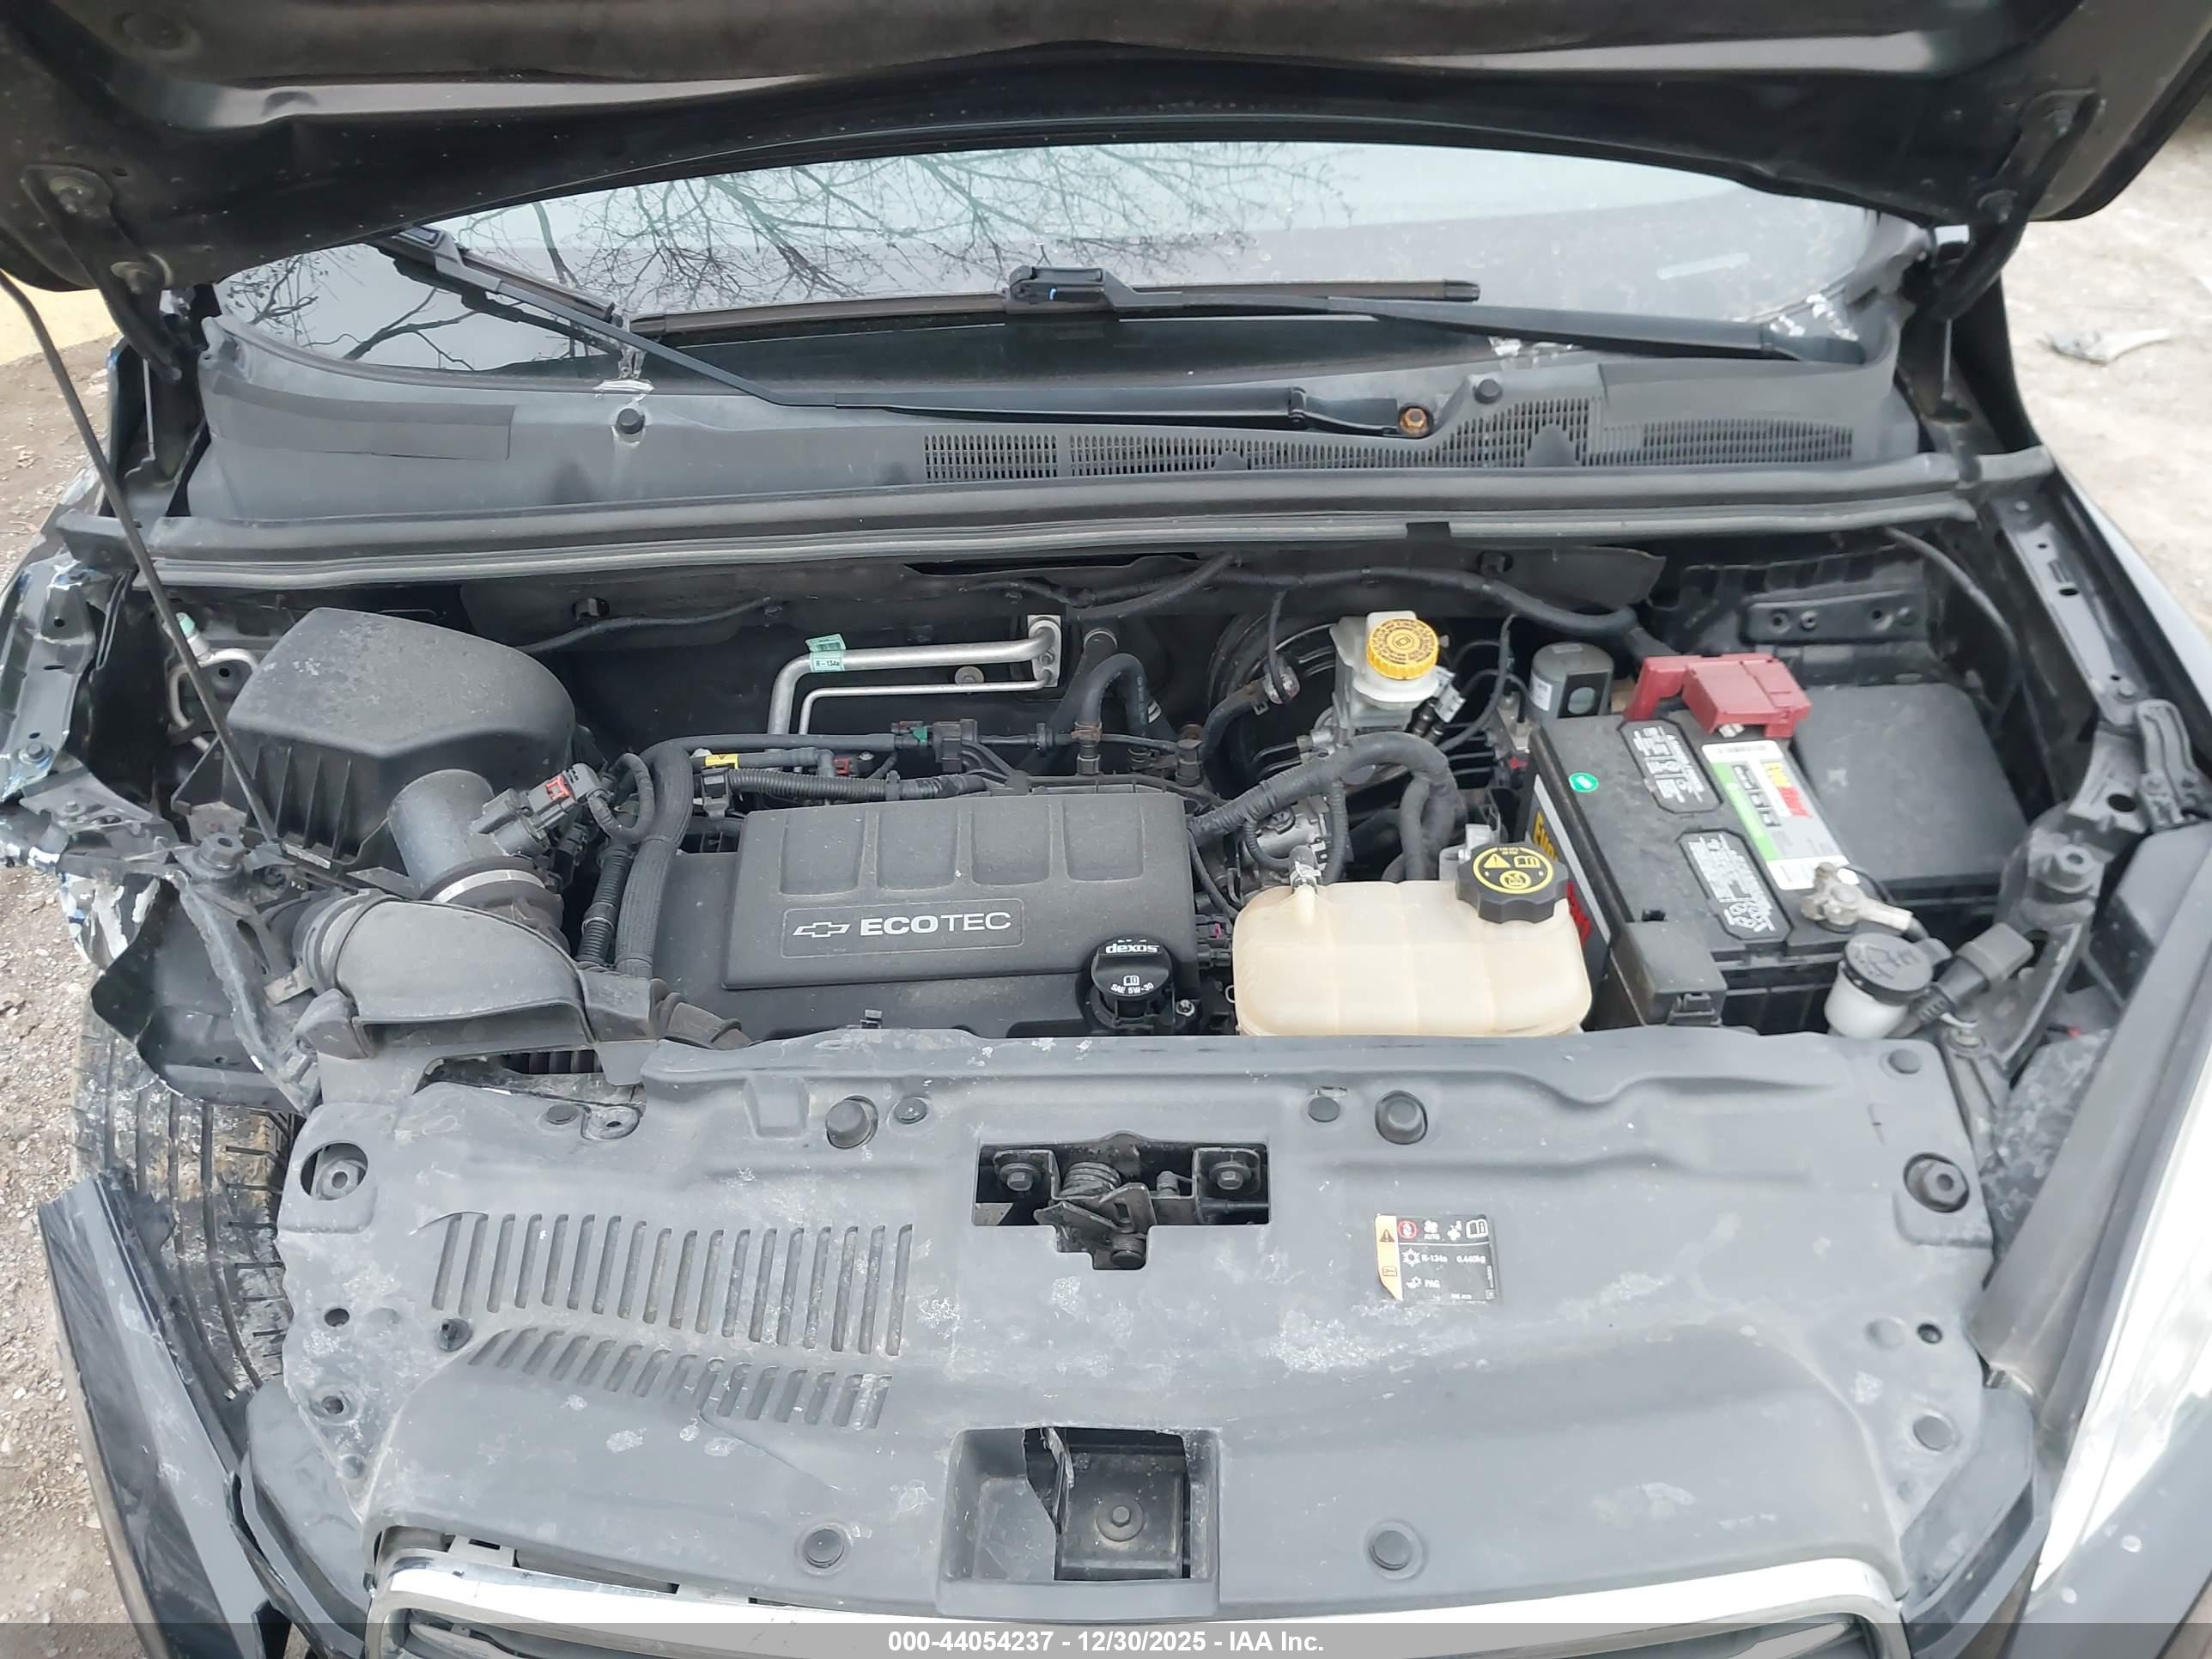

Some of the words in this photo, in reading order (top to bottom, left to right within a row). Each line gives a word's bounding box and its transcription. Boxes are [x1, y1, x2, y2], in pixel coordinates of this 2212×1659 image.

[860, 912, 1012, 936] ECOTEC
[1105, 943, 1160, 954] dexos
[1110, 983, 1127, 994] SAE
[1127, 982, 1154, 994] 5W-30
